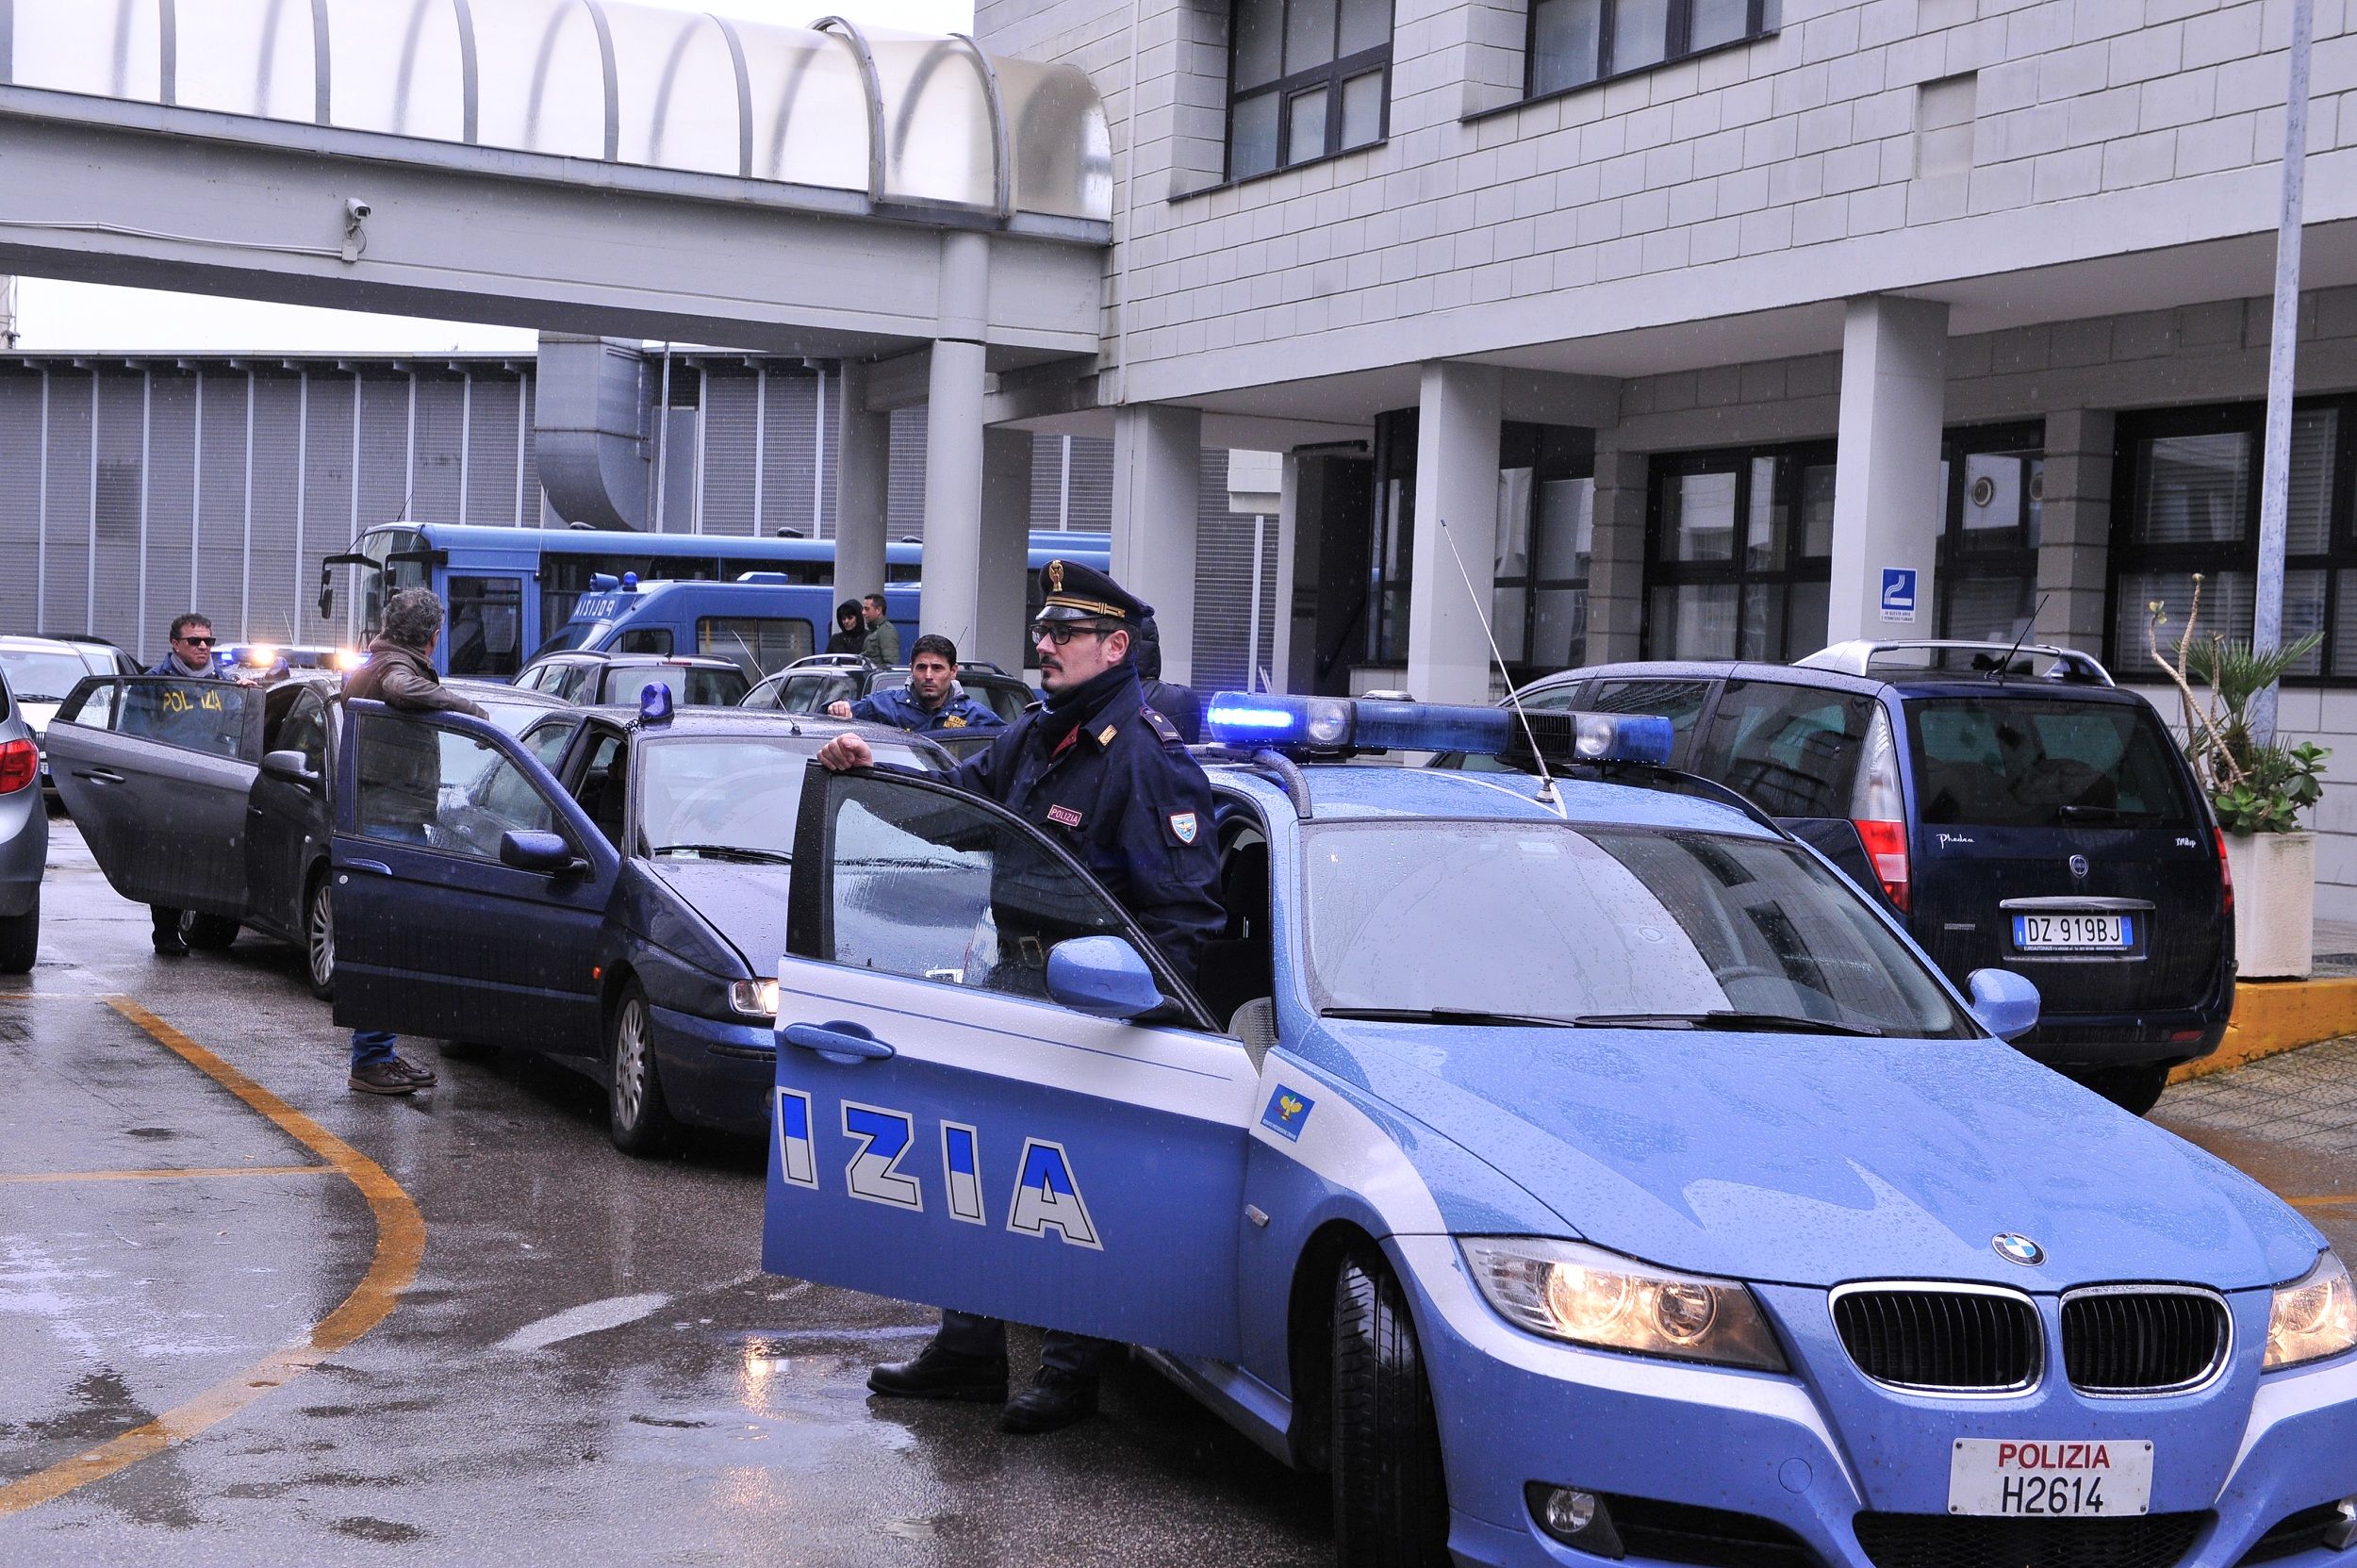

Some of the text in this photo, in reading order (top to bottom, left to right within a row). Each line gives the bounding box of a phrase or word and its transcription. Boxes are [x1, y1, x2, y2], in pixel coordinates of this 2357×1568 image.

[1050, 808, 1079, 823] POLIZIA
[2027, 918, 2120, 942] DZ 919BJ
[1998, 1443, 2111, 1469] POLIZIA
[2001, 1476, 2104, 1513] H2614
